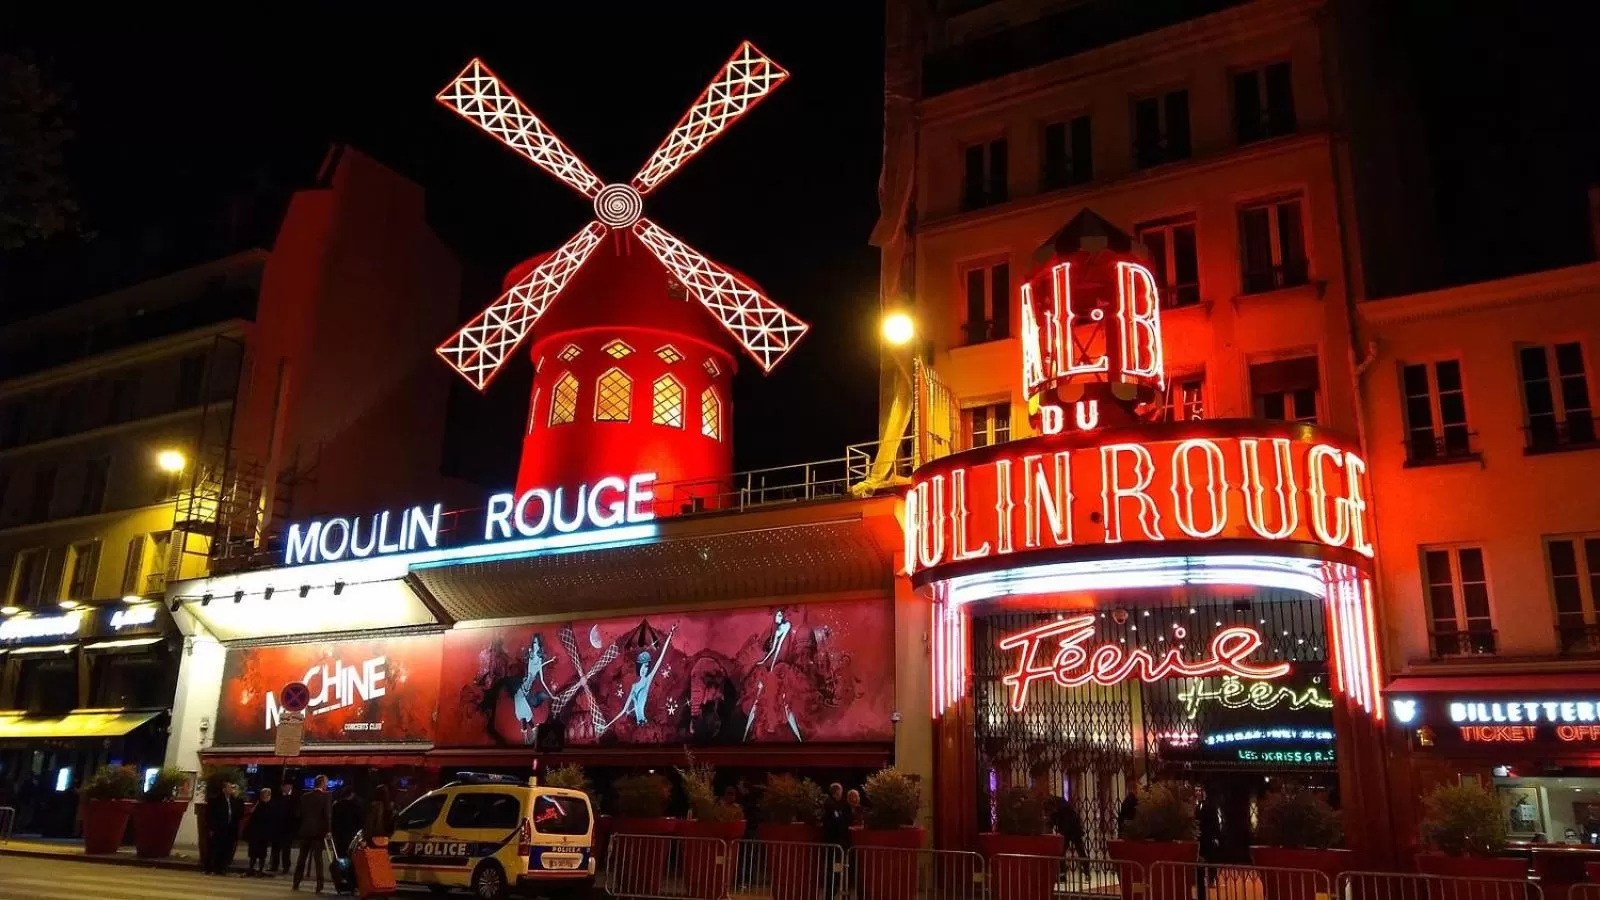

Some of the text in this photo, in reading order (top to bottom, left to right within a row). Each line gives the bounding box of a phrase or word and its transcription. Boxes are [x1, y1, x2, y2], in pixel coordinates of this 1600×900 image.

[1040, 400, 1099, 435] DU
[284, 472, 658, 565] MOULIN ROUGE
[1101, 437, 1375, 559] ROUGE
[265, 655, 386, 730] MCHINE
[1000, 615, 1290, 713] Féerie
[1459, 725, 1537, 742] TICKET
[413, 842, 468, 856] POLICE
